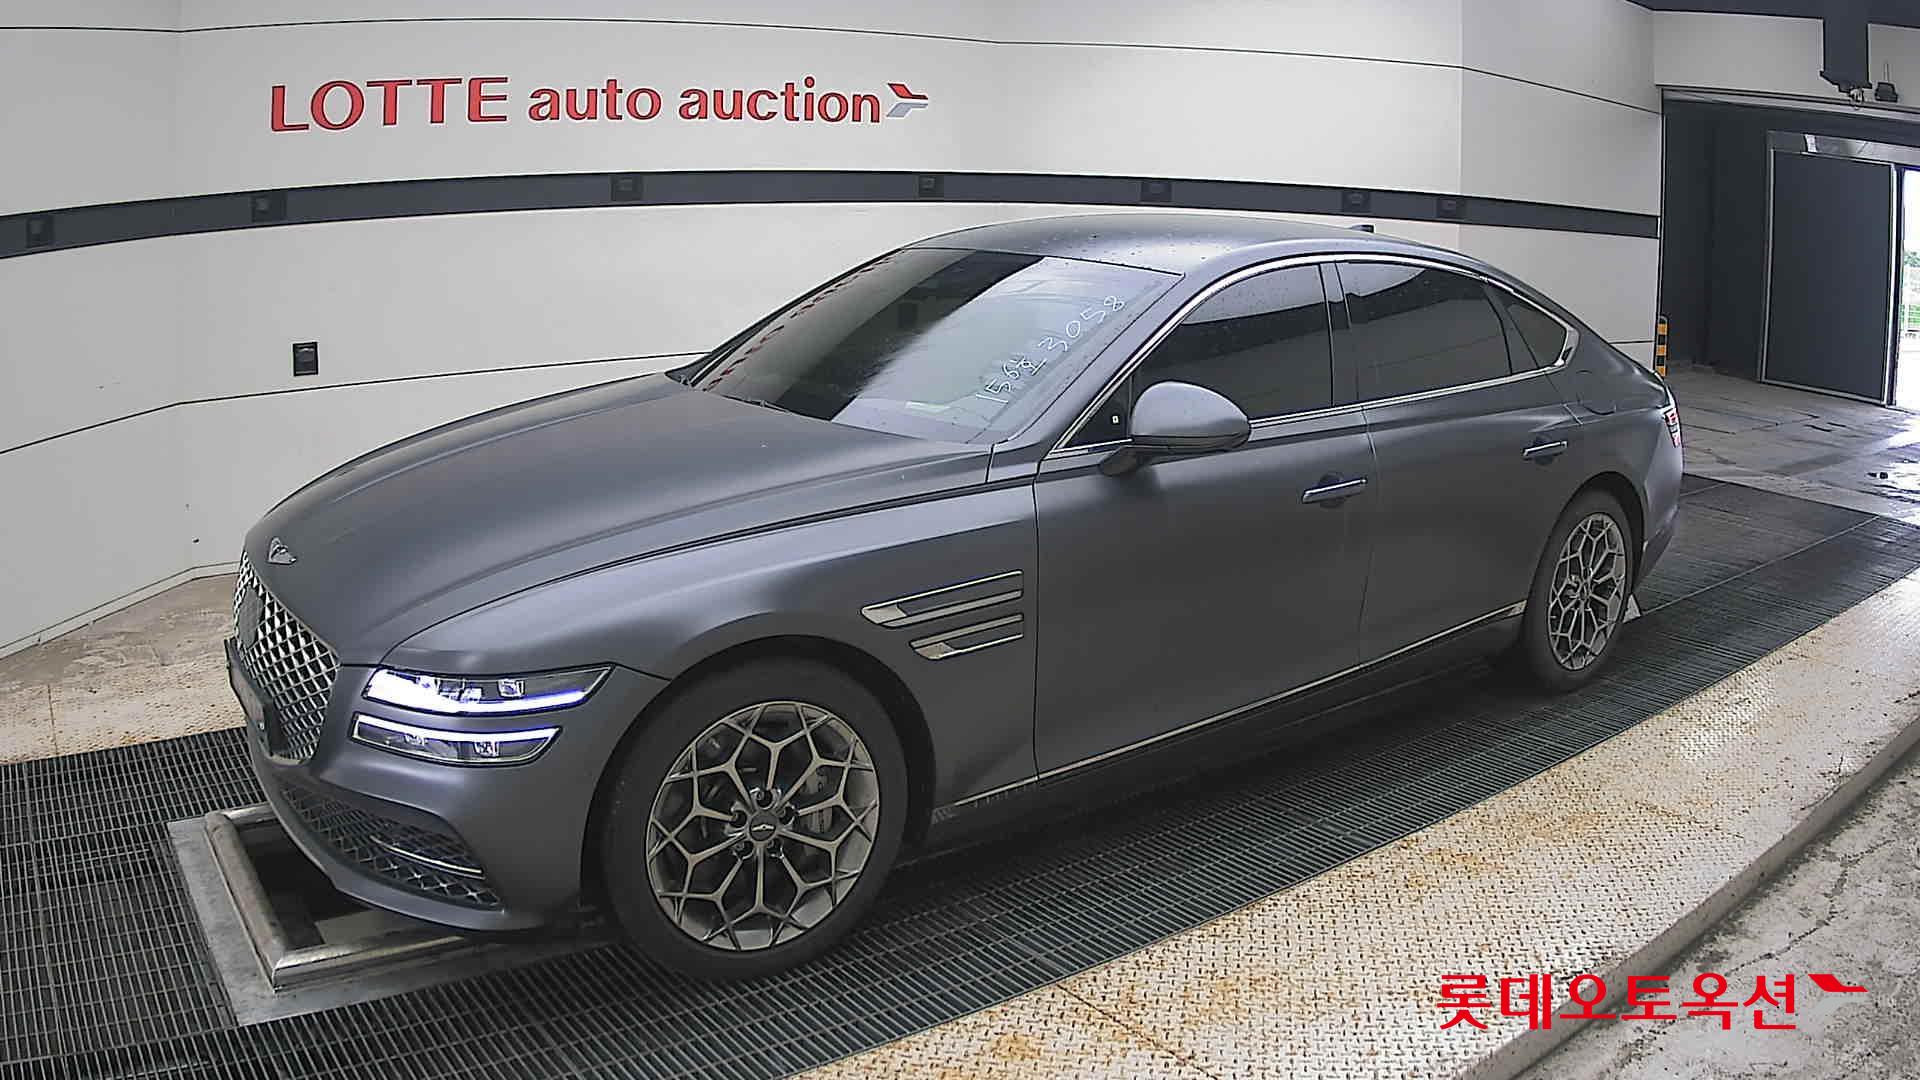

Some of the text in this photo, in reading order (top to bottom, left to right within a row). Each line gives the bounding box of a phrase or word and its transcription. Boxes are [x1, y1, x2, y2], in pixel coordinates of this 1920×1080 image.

[270, 76, 881, 132] LOTTE auto auction
[1038, 295, 1126, 353] 3058
